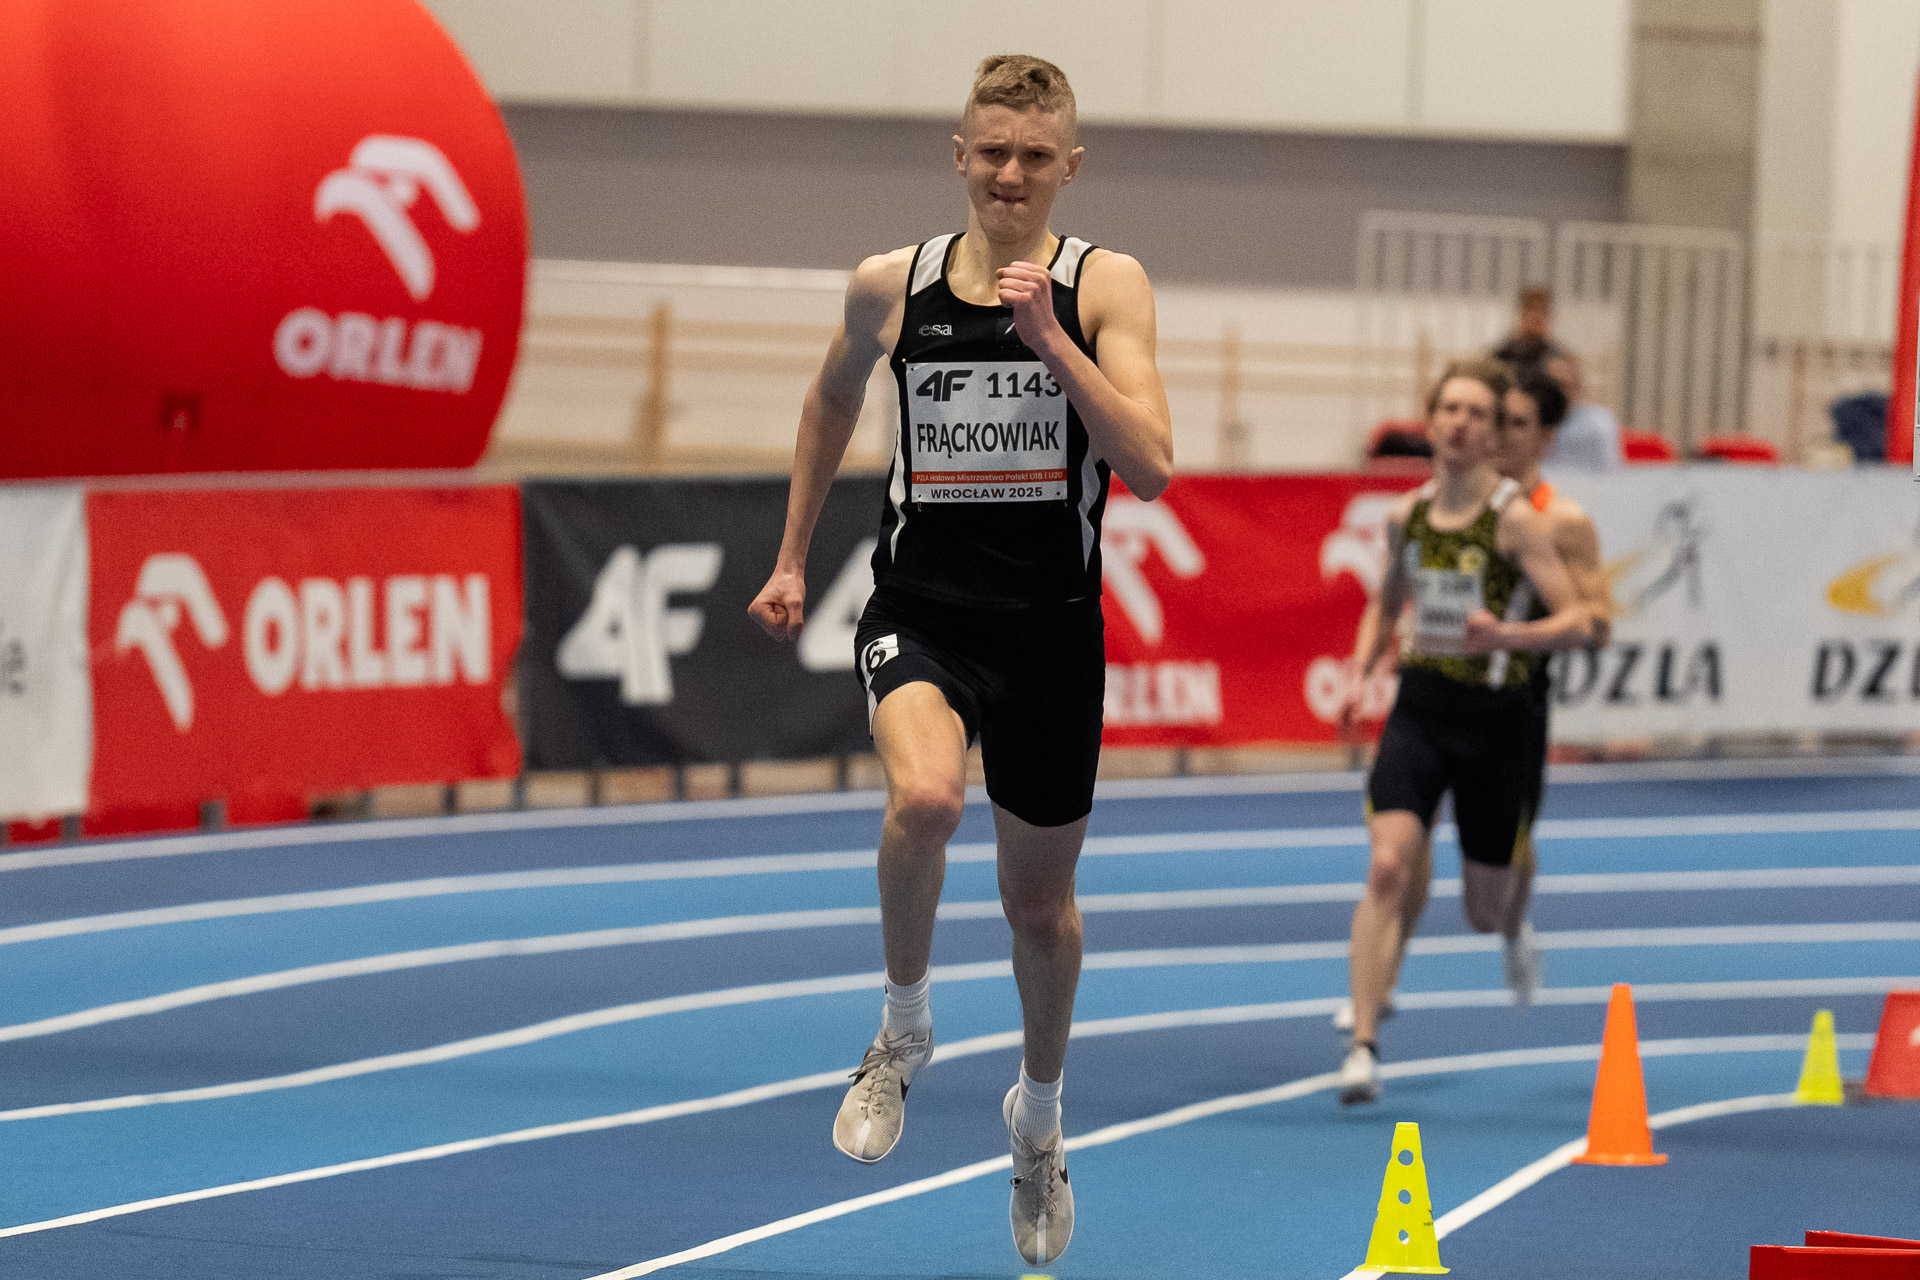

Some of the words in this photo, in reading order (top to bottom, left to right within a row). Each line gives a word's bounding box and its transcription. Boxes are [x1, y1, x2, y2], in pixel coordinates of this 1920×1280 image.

[273, 306, 483, 395] ORLEN
[915, 370, 973, 402] 4F
[986, 371, 1062, 399] 1143
[917, 421, 1060, 459] FRĄCKOWIAK
[930, 474, 956, 482] Halowe
[957, 473, 1004, 482] Mistrzostwa
[1006, 473, 1028, 481] Polski
[1030, 472, 1043, 480] U18
[1049, 471, 1063, 479] U20
[931, 488, 1005, 499] WROCŁAW
[1008, 486, 1043, 498] 2025
[243, 574, 492, 696] ORLEN
[556, 541, 724, 706] 4F
[865, 640, 887, 677] 6
[1551, 639, 1723, 705] DZLA
